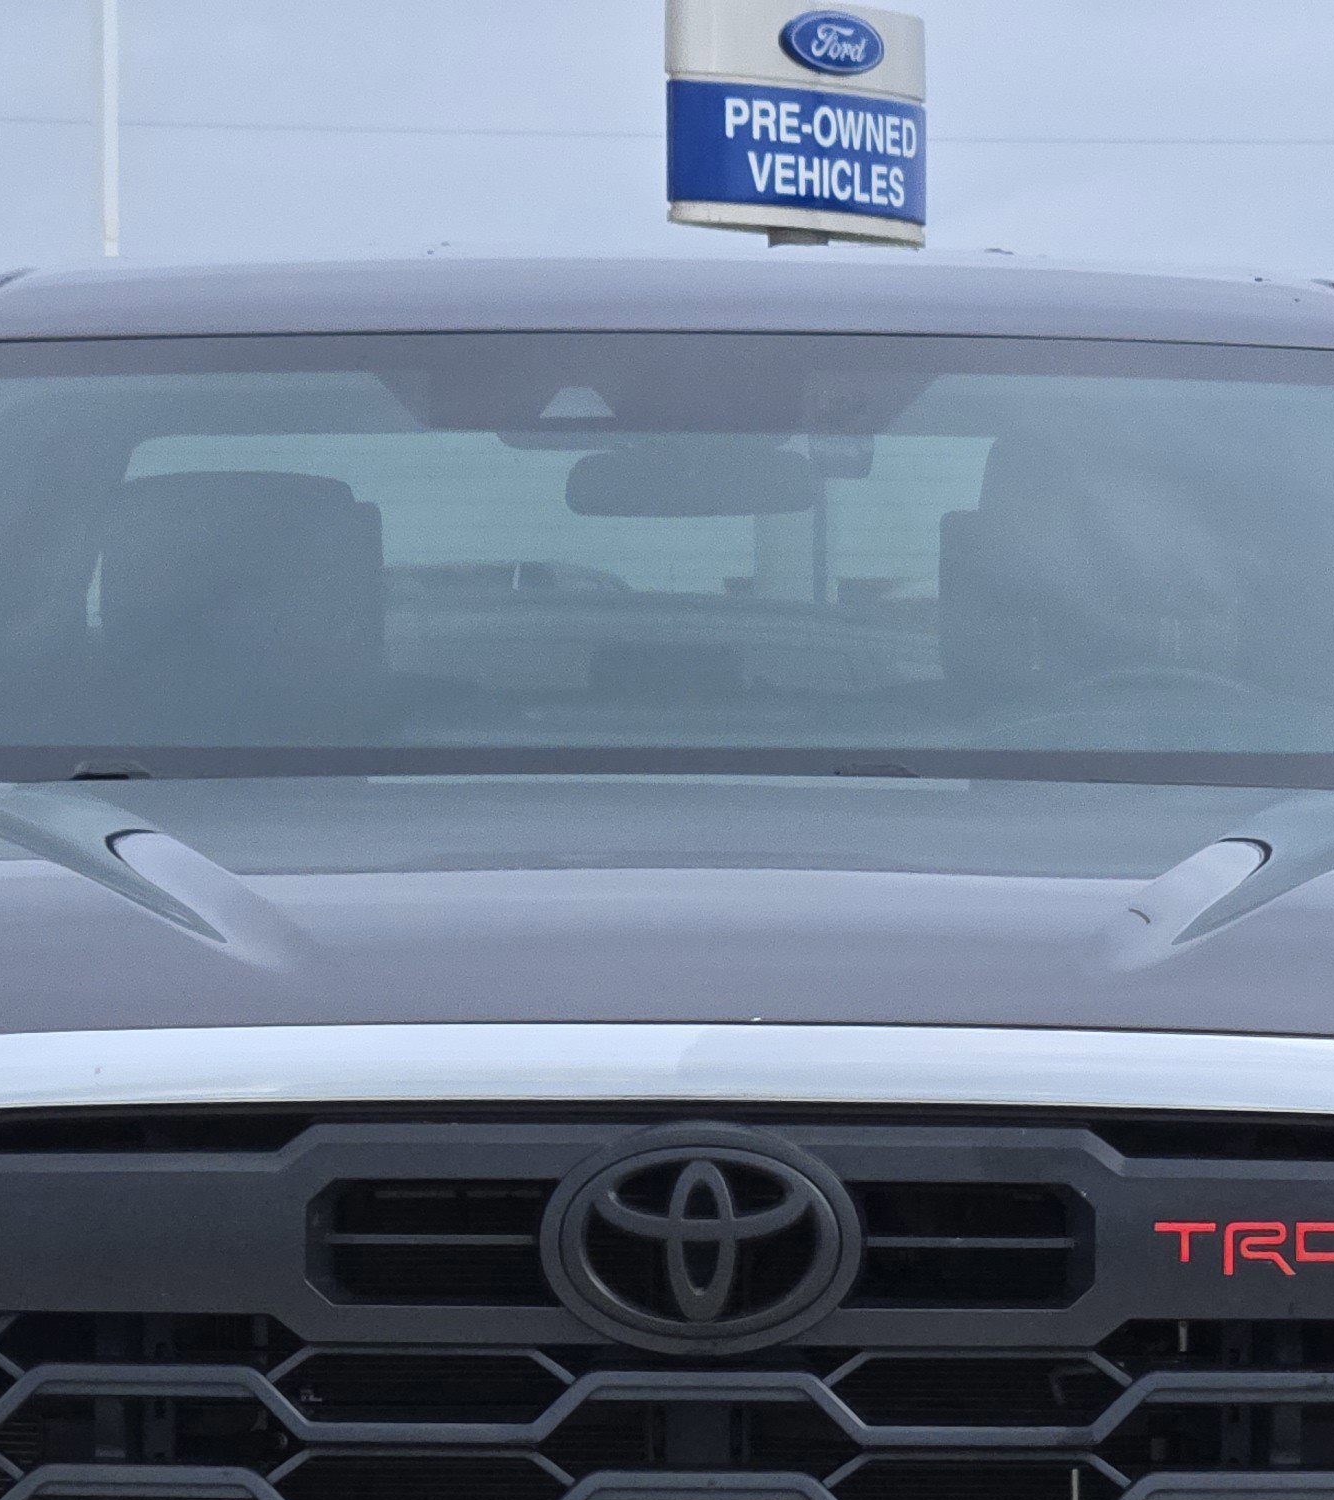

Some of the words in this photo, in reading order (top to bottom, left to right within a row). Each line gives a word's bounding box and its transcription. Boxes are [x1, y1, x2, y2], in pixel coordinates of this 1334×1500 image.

[811, 24, 866, 62] Ford
[724, 97, 917, 158] PRE-OWNED
[747, 151, 905, 208] VEHICLES
